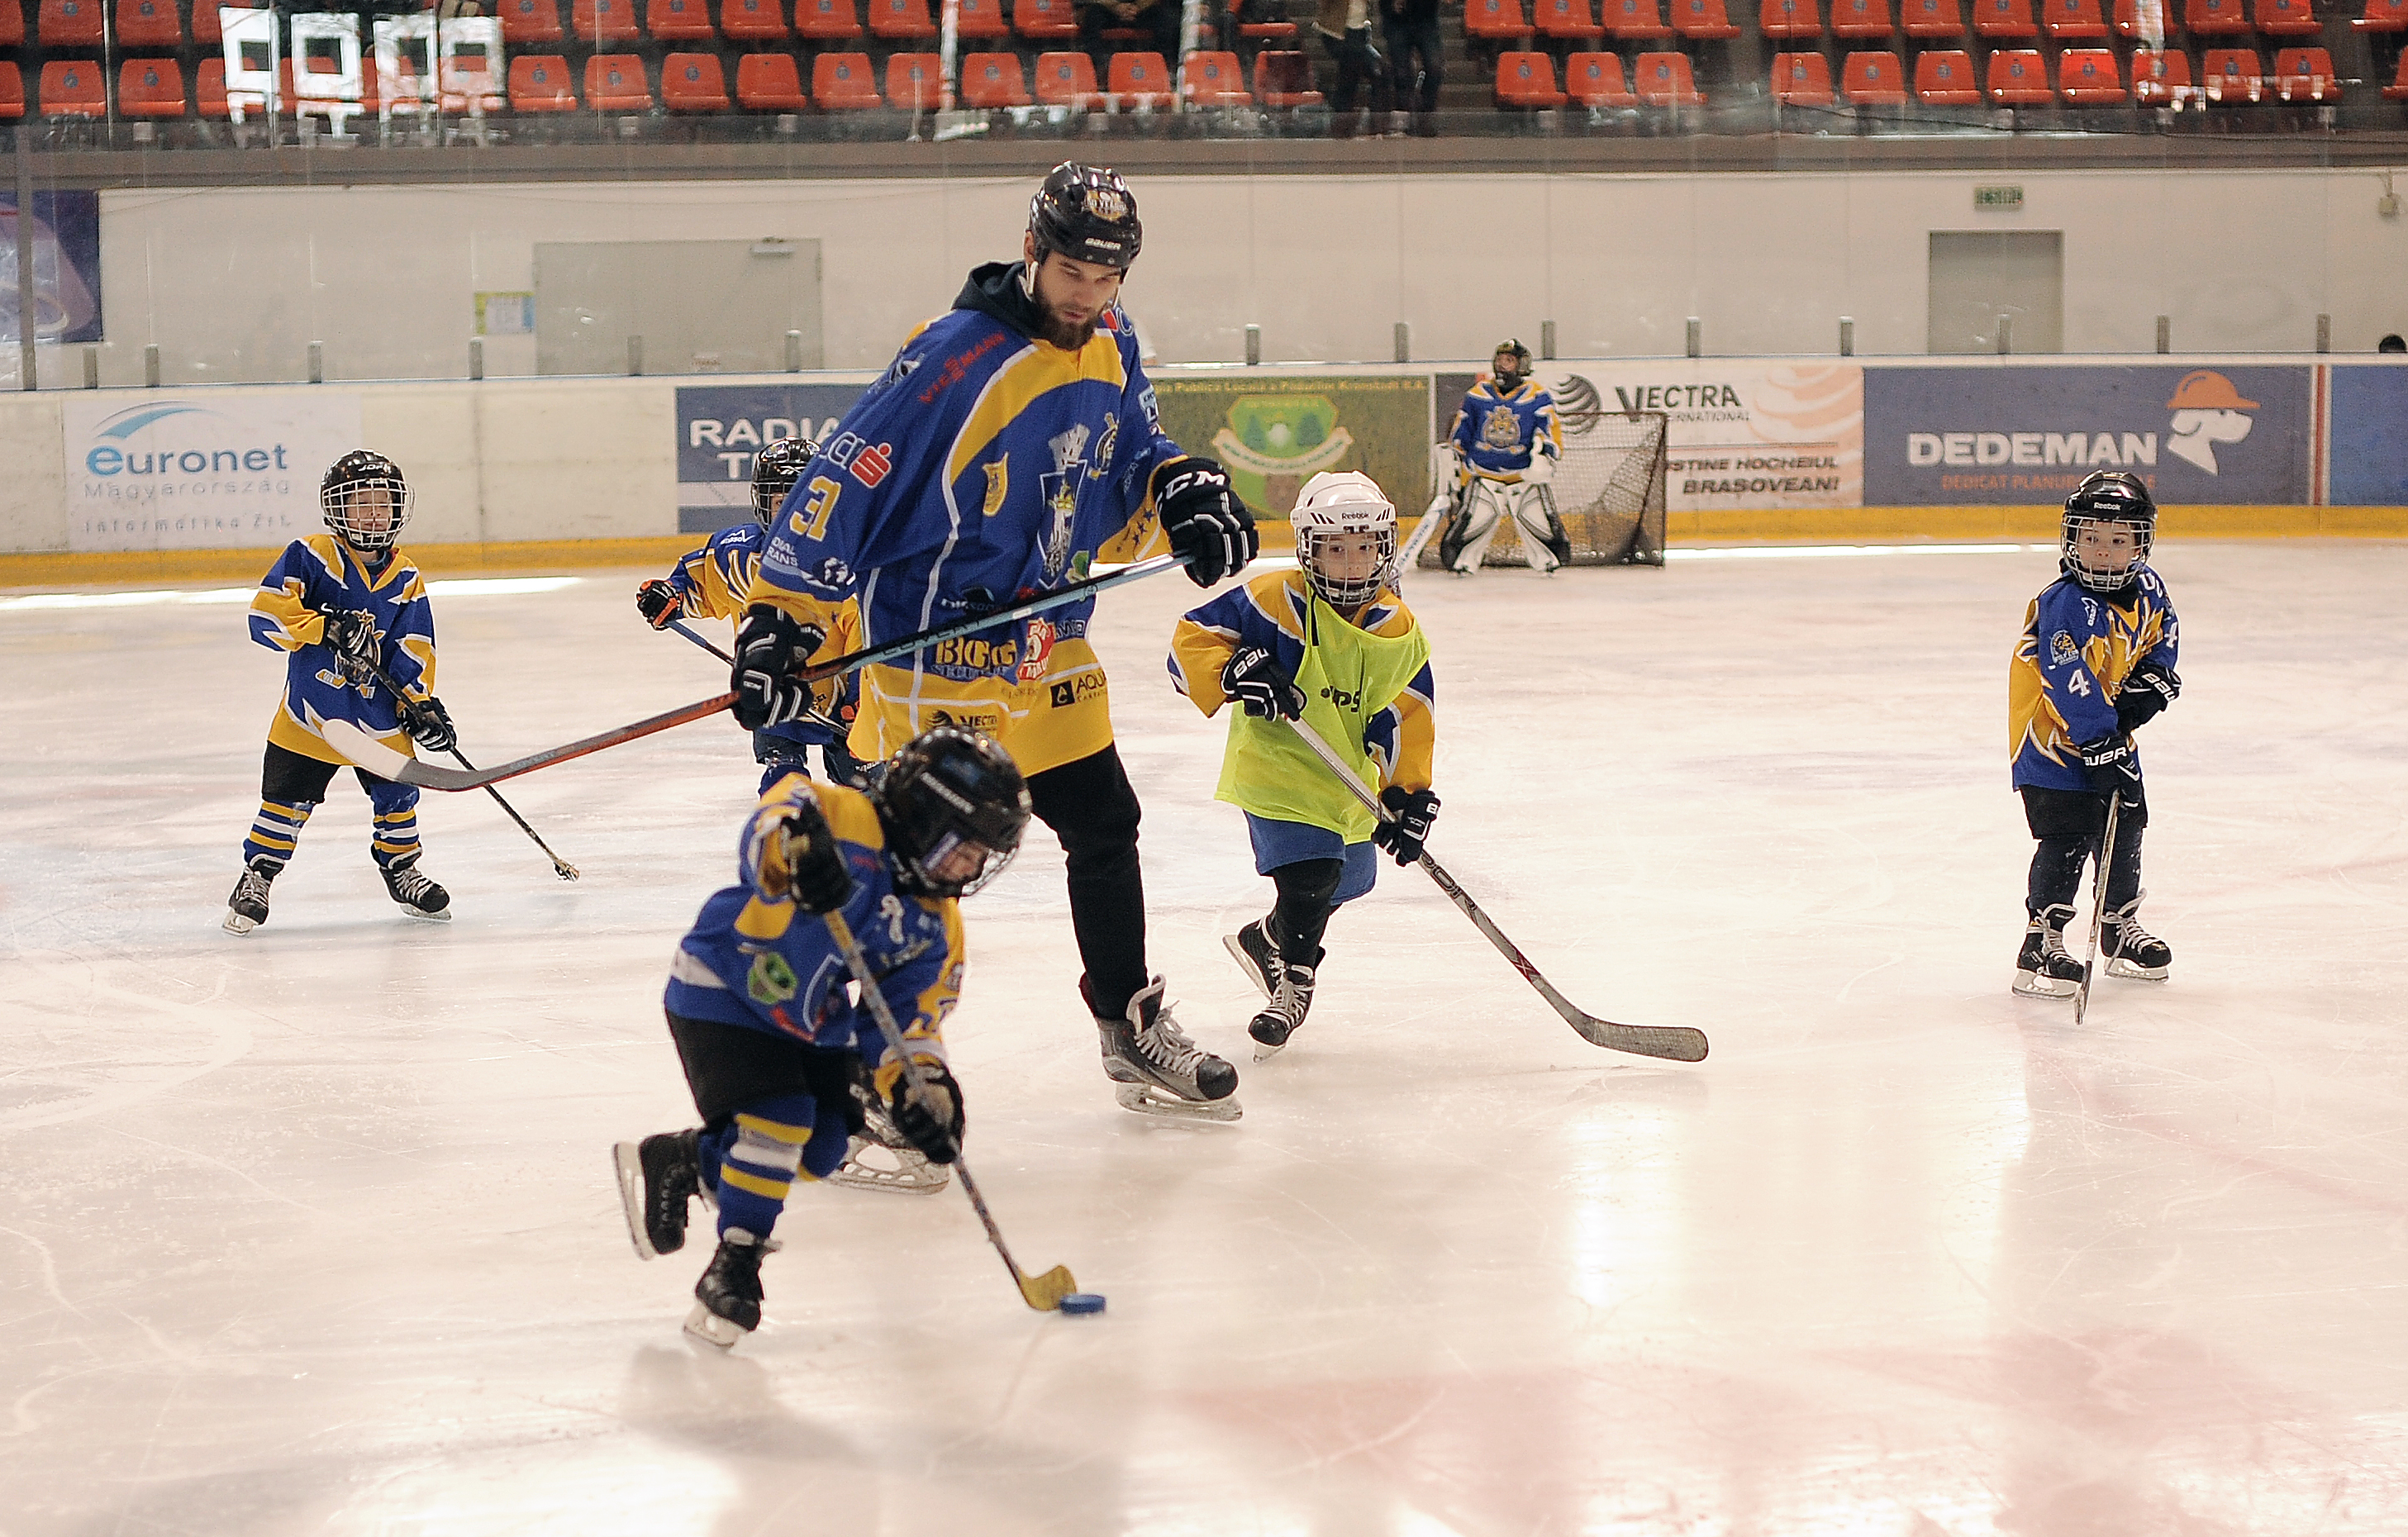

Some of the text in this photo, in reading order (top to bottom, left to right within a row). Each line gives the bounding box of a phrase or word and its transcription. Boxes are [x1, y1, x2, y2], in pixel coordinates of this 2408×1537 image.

[1615, 384, 1743, 422] VECTRA
[85, 443, 288, 477] euronet
[1908, 431, 2158, 467] DEDEMAN
[1341, 511, 1369, 520] Reebok
[2068, 669, 2091, 697] 4
